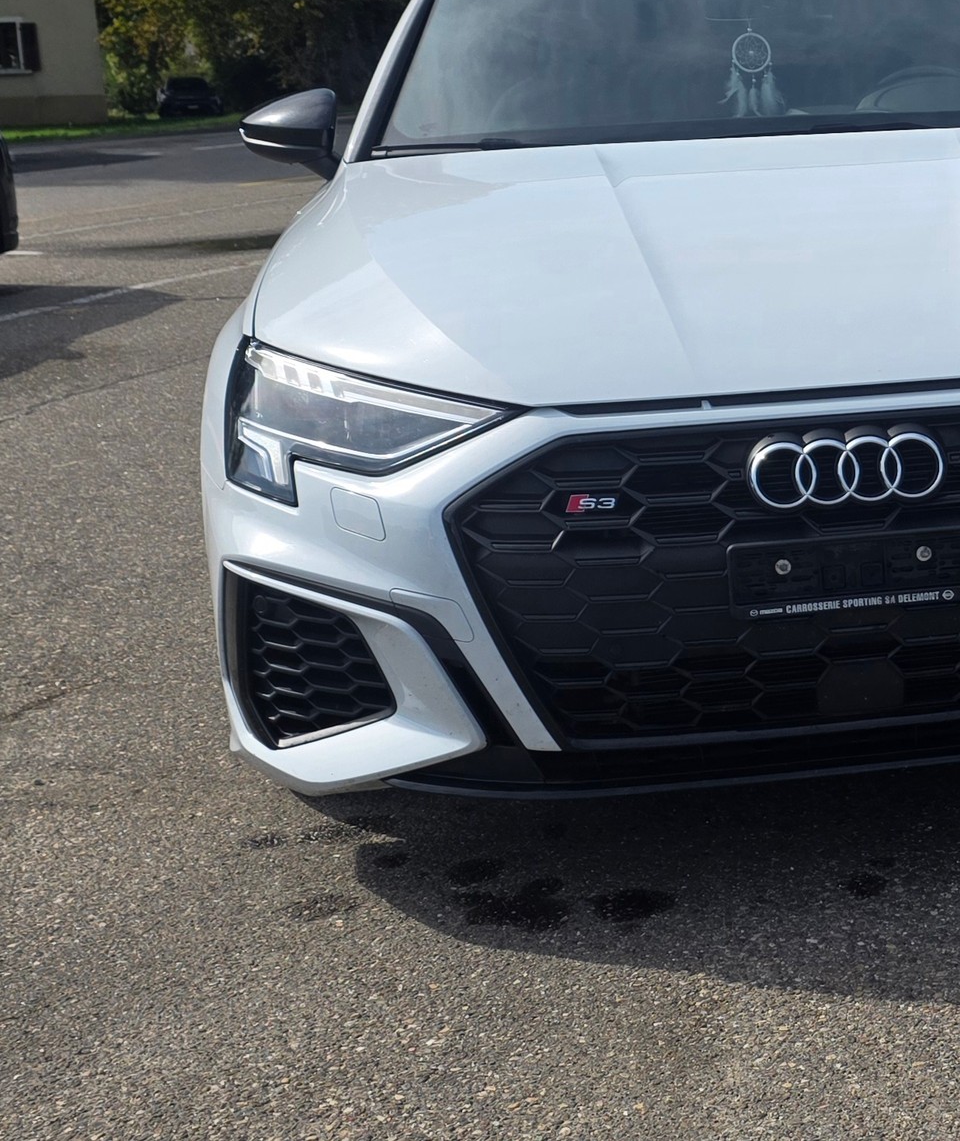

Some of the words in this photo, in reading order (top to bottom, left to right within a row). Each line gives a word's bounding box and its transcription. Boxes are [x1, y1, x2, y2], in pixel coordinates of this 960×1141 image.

[578, 497, 616, 510] S3
[785, 600, 841, 614] CARROSSERIE
[842, 596, 882, 609] SPORTING
[884, 594, 896, 604] SA
[898, 591, 940, 603] DELEMONT
